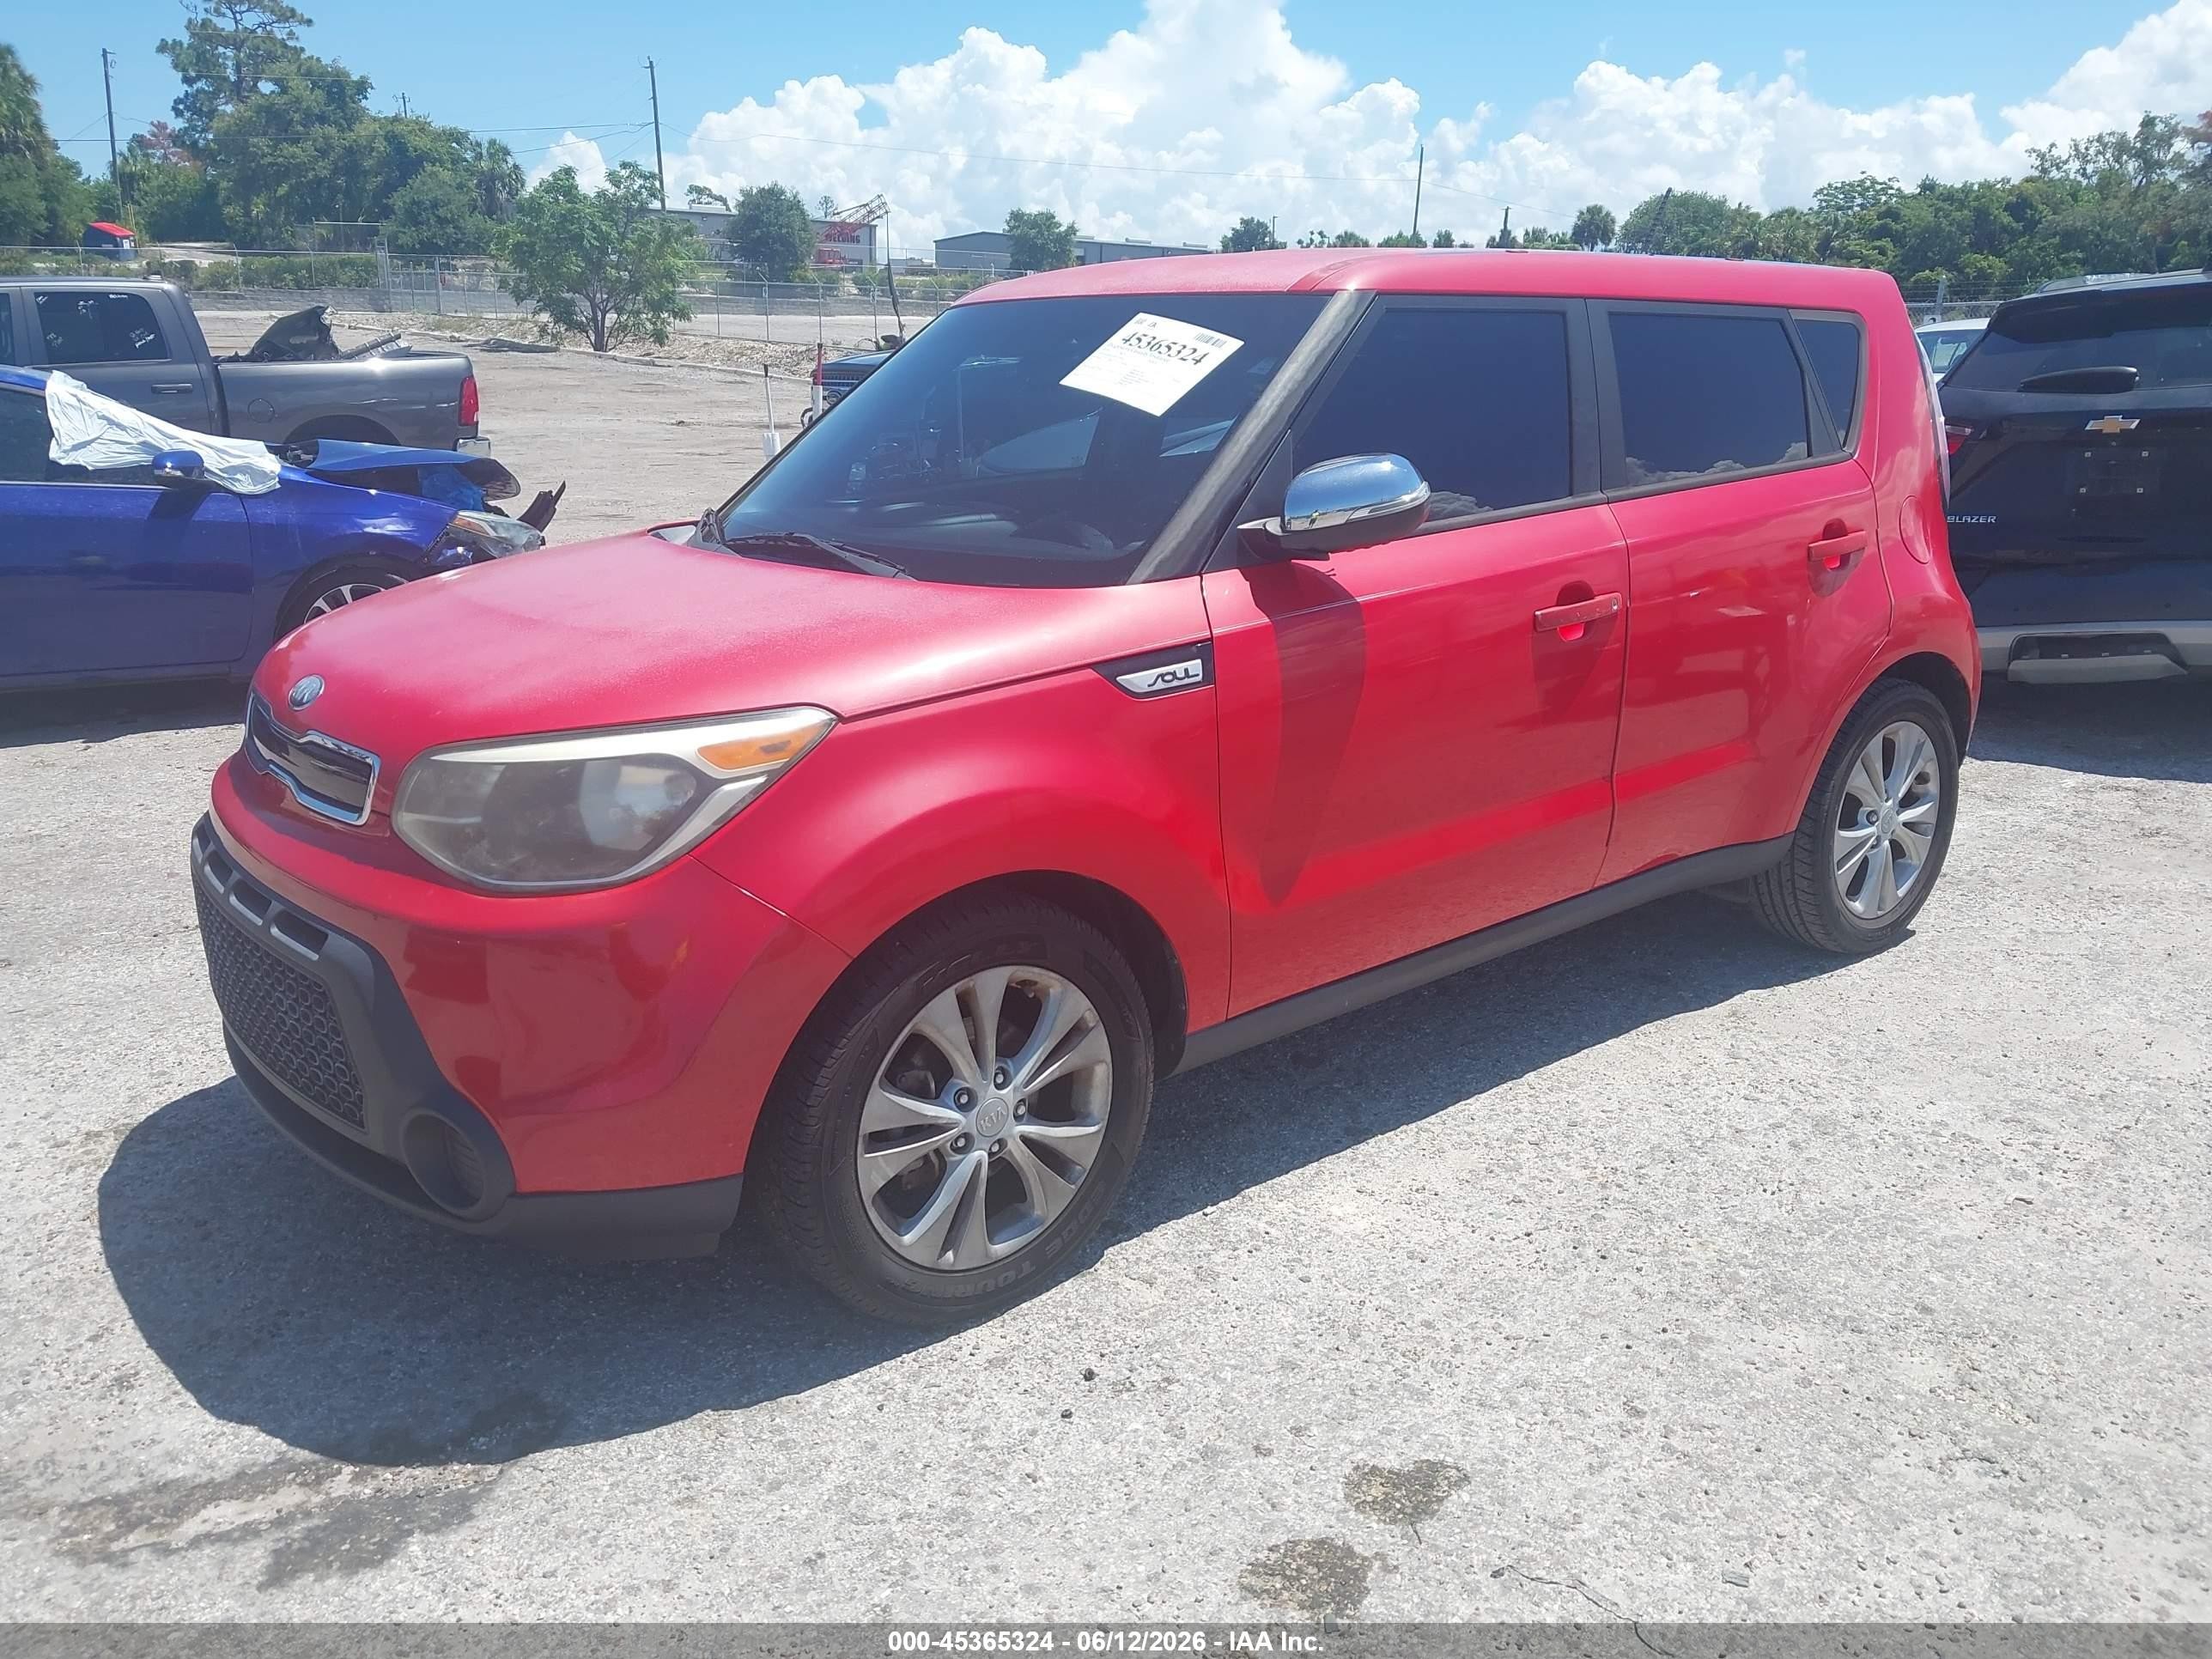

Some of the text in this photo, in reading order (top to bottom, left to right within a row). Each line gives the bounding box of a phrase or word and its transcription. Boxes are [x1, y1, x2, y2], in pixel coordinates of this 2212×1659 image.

[1122, 331, 1210, 365] 45365324
[1147, 667, 1200, 688] SOUL
[981, 1106, 1007, 1131] KIA
